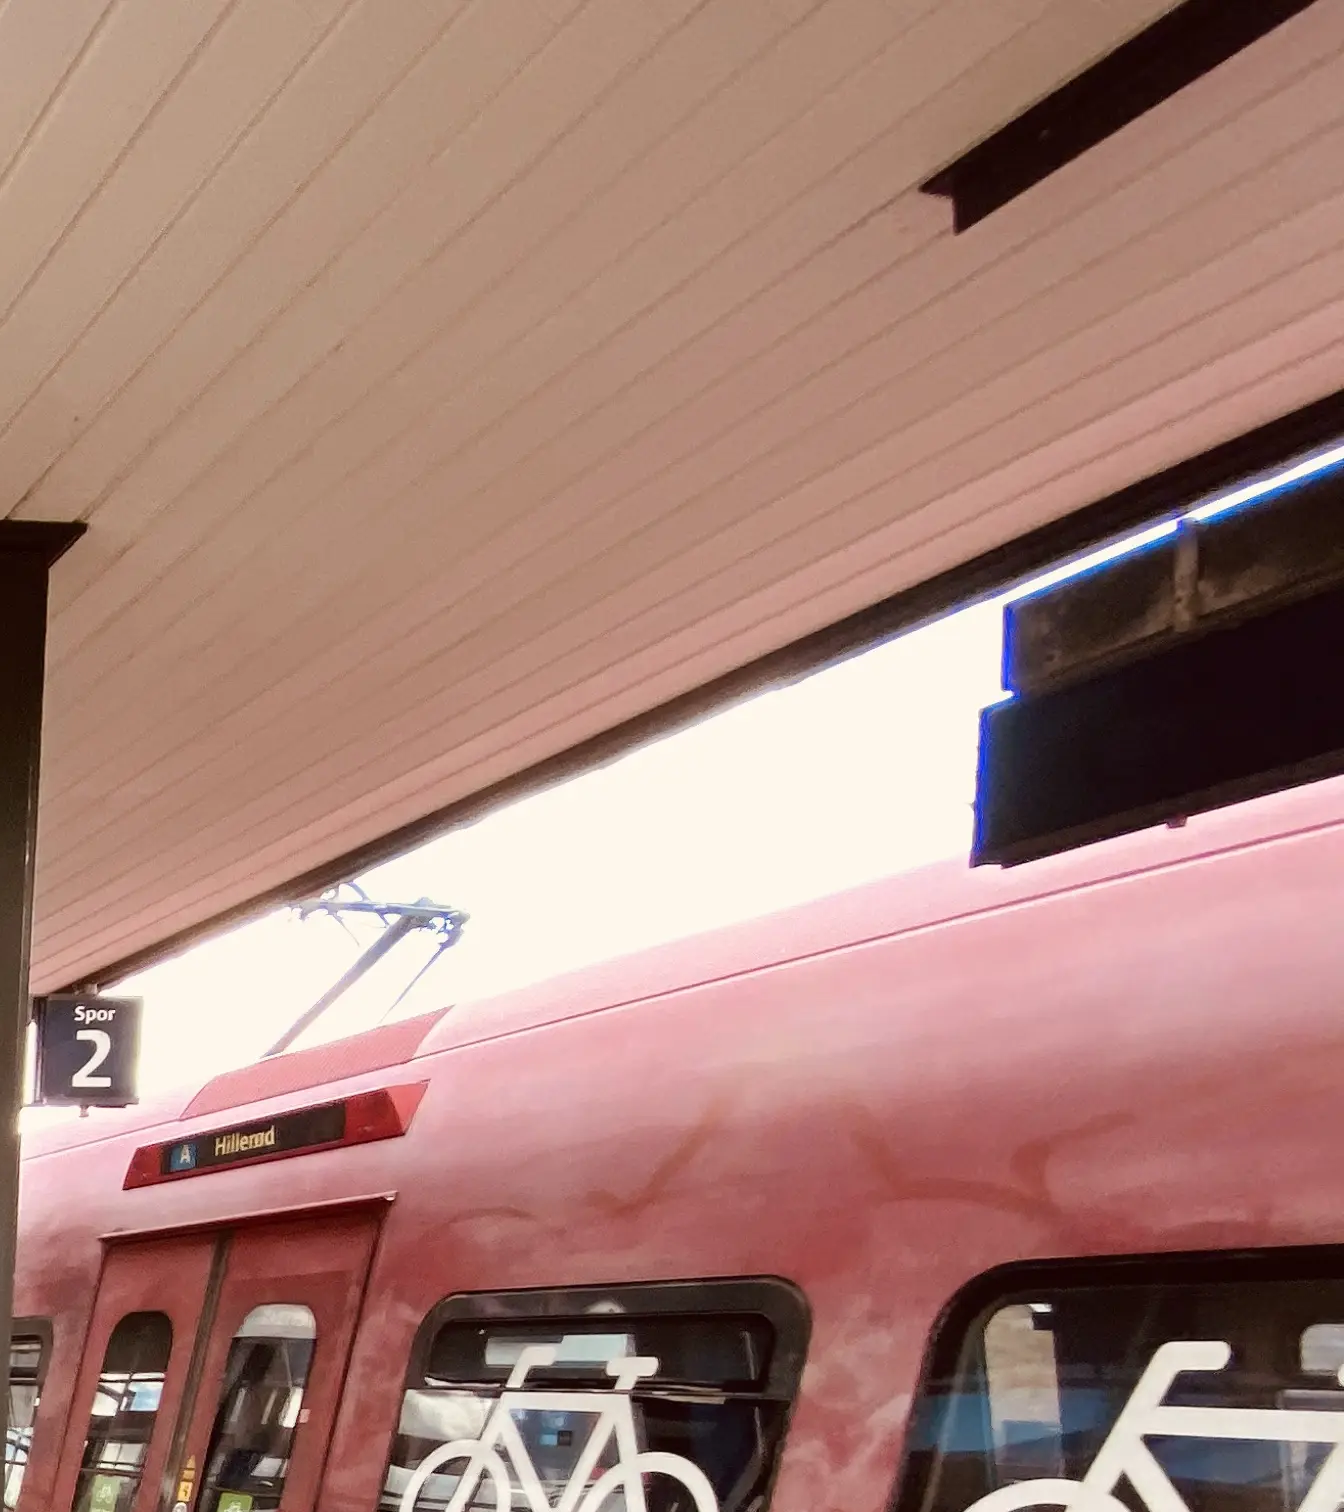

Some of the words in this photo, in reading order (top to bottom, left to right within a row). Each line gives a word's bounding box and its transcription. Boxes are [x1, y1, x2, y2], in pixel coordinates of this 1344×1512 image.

[74, 1005, 116, 1025] Spor
[72, 1029, 112, 1088] 2
[179, 1144, 192, 1164] A
[214, 1125, 276, 1157] Hillerød
